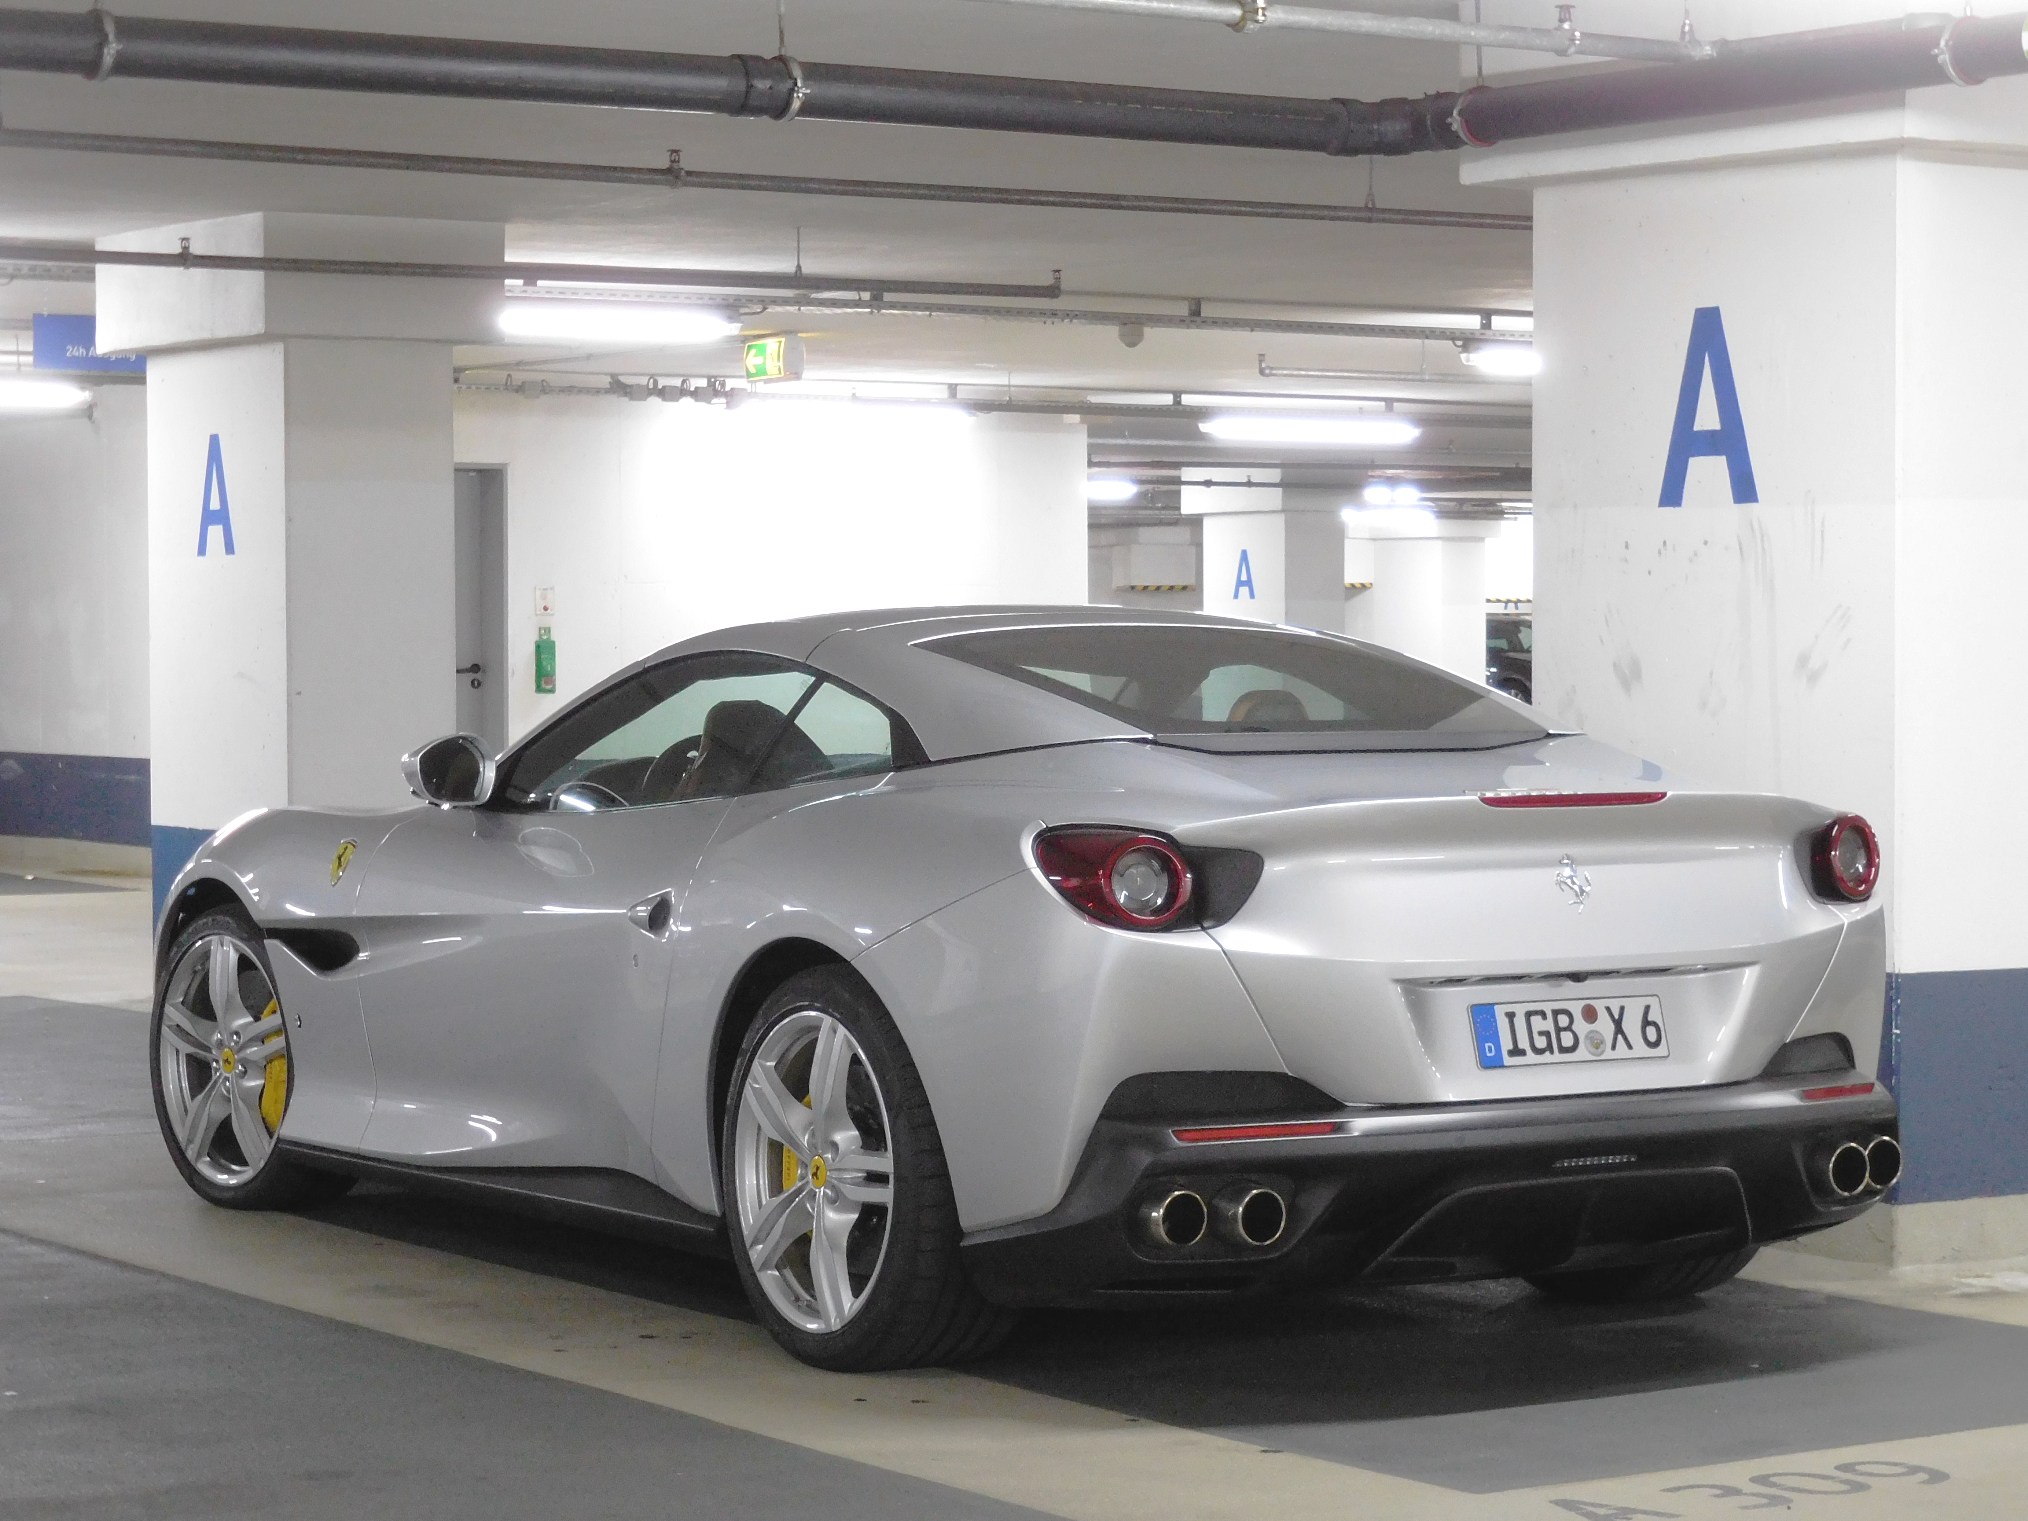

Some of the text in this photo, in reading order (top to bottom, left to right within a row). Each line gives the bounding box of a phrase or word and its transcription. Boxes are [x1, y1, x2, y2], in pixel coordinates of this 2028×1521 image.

[65, 344, 87, 357] 24h
[1658, 306, 1759, 507] A
[197, 433, 235, 556] A
[1233, 549, 1256, 600] A
[1485, 1042, 1495, 1056] D
[1504, 1008, 1580, 1058] IGB
[1549, 1460, 1950, 1521] A 309
